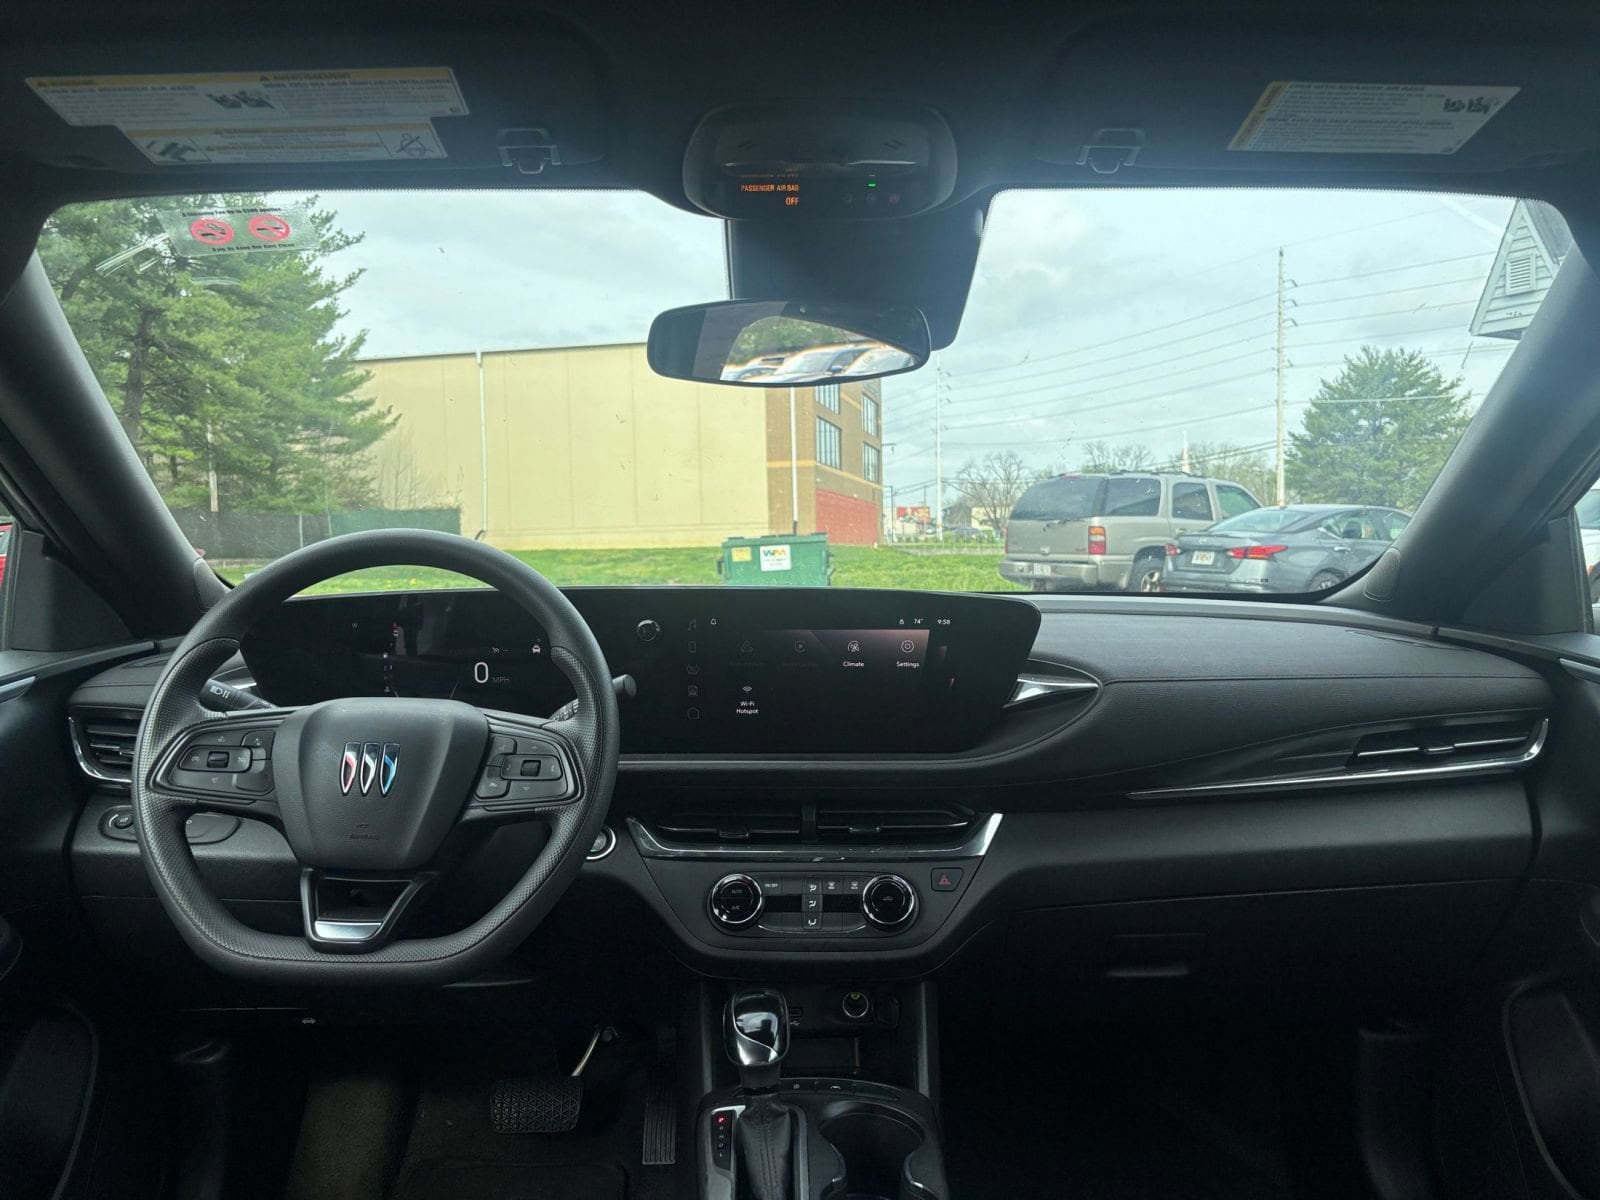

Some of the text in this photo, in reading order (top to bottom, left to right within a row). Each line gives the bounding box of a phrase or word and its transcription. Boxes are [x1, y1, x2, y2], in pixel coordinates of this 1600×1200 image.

[740, 184, 800, 192] PASSENGER AIR BAG
[785, 197, 800, 206] OFF
[896, 661, 920, 669] Settings
[474, 661, 489, 684] 0
[736, 708, 759, 716] Hotspot
